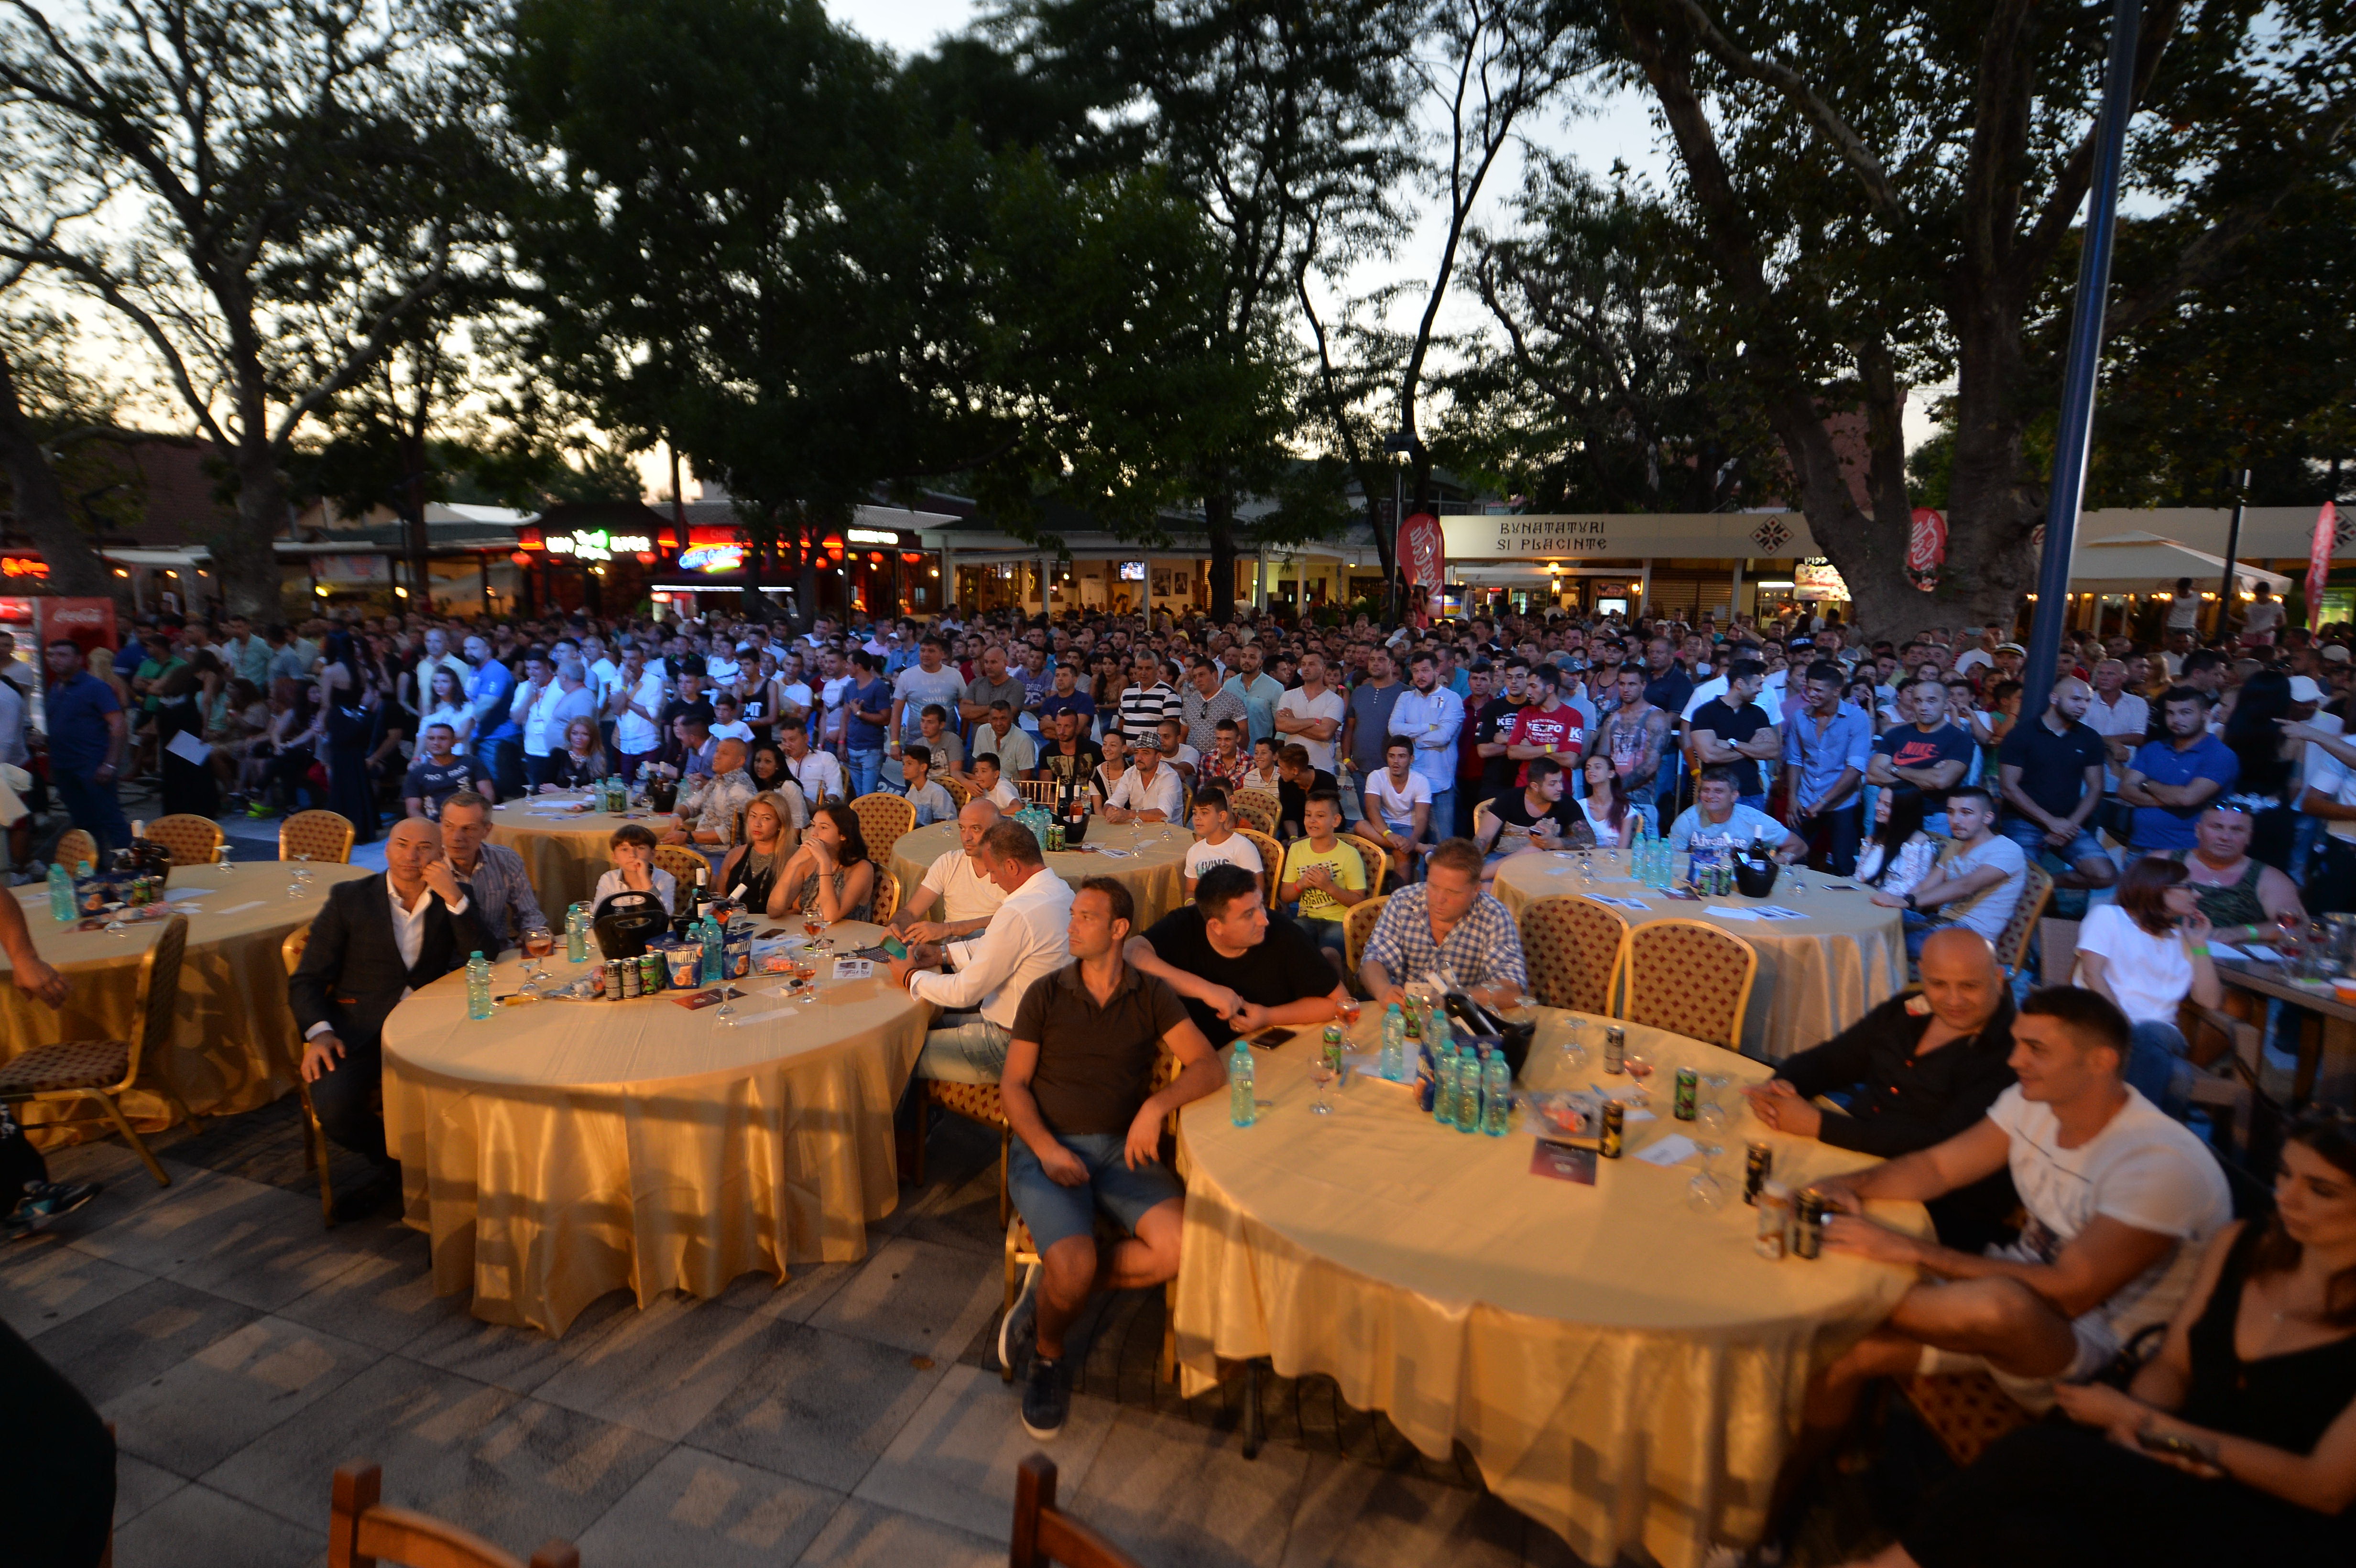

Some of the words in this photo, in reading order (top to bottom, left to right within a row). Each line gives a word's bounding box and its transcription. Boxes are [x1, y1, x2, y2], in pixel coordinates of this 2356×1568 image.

[1496, 539, 1510, 550] SI
[1521, 538, 1607, 550] PLACINTE
[1691, 831, 1747, 848] Advenre
